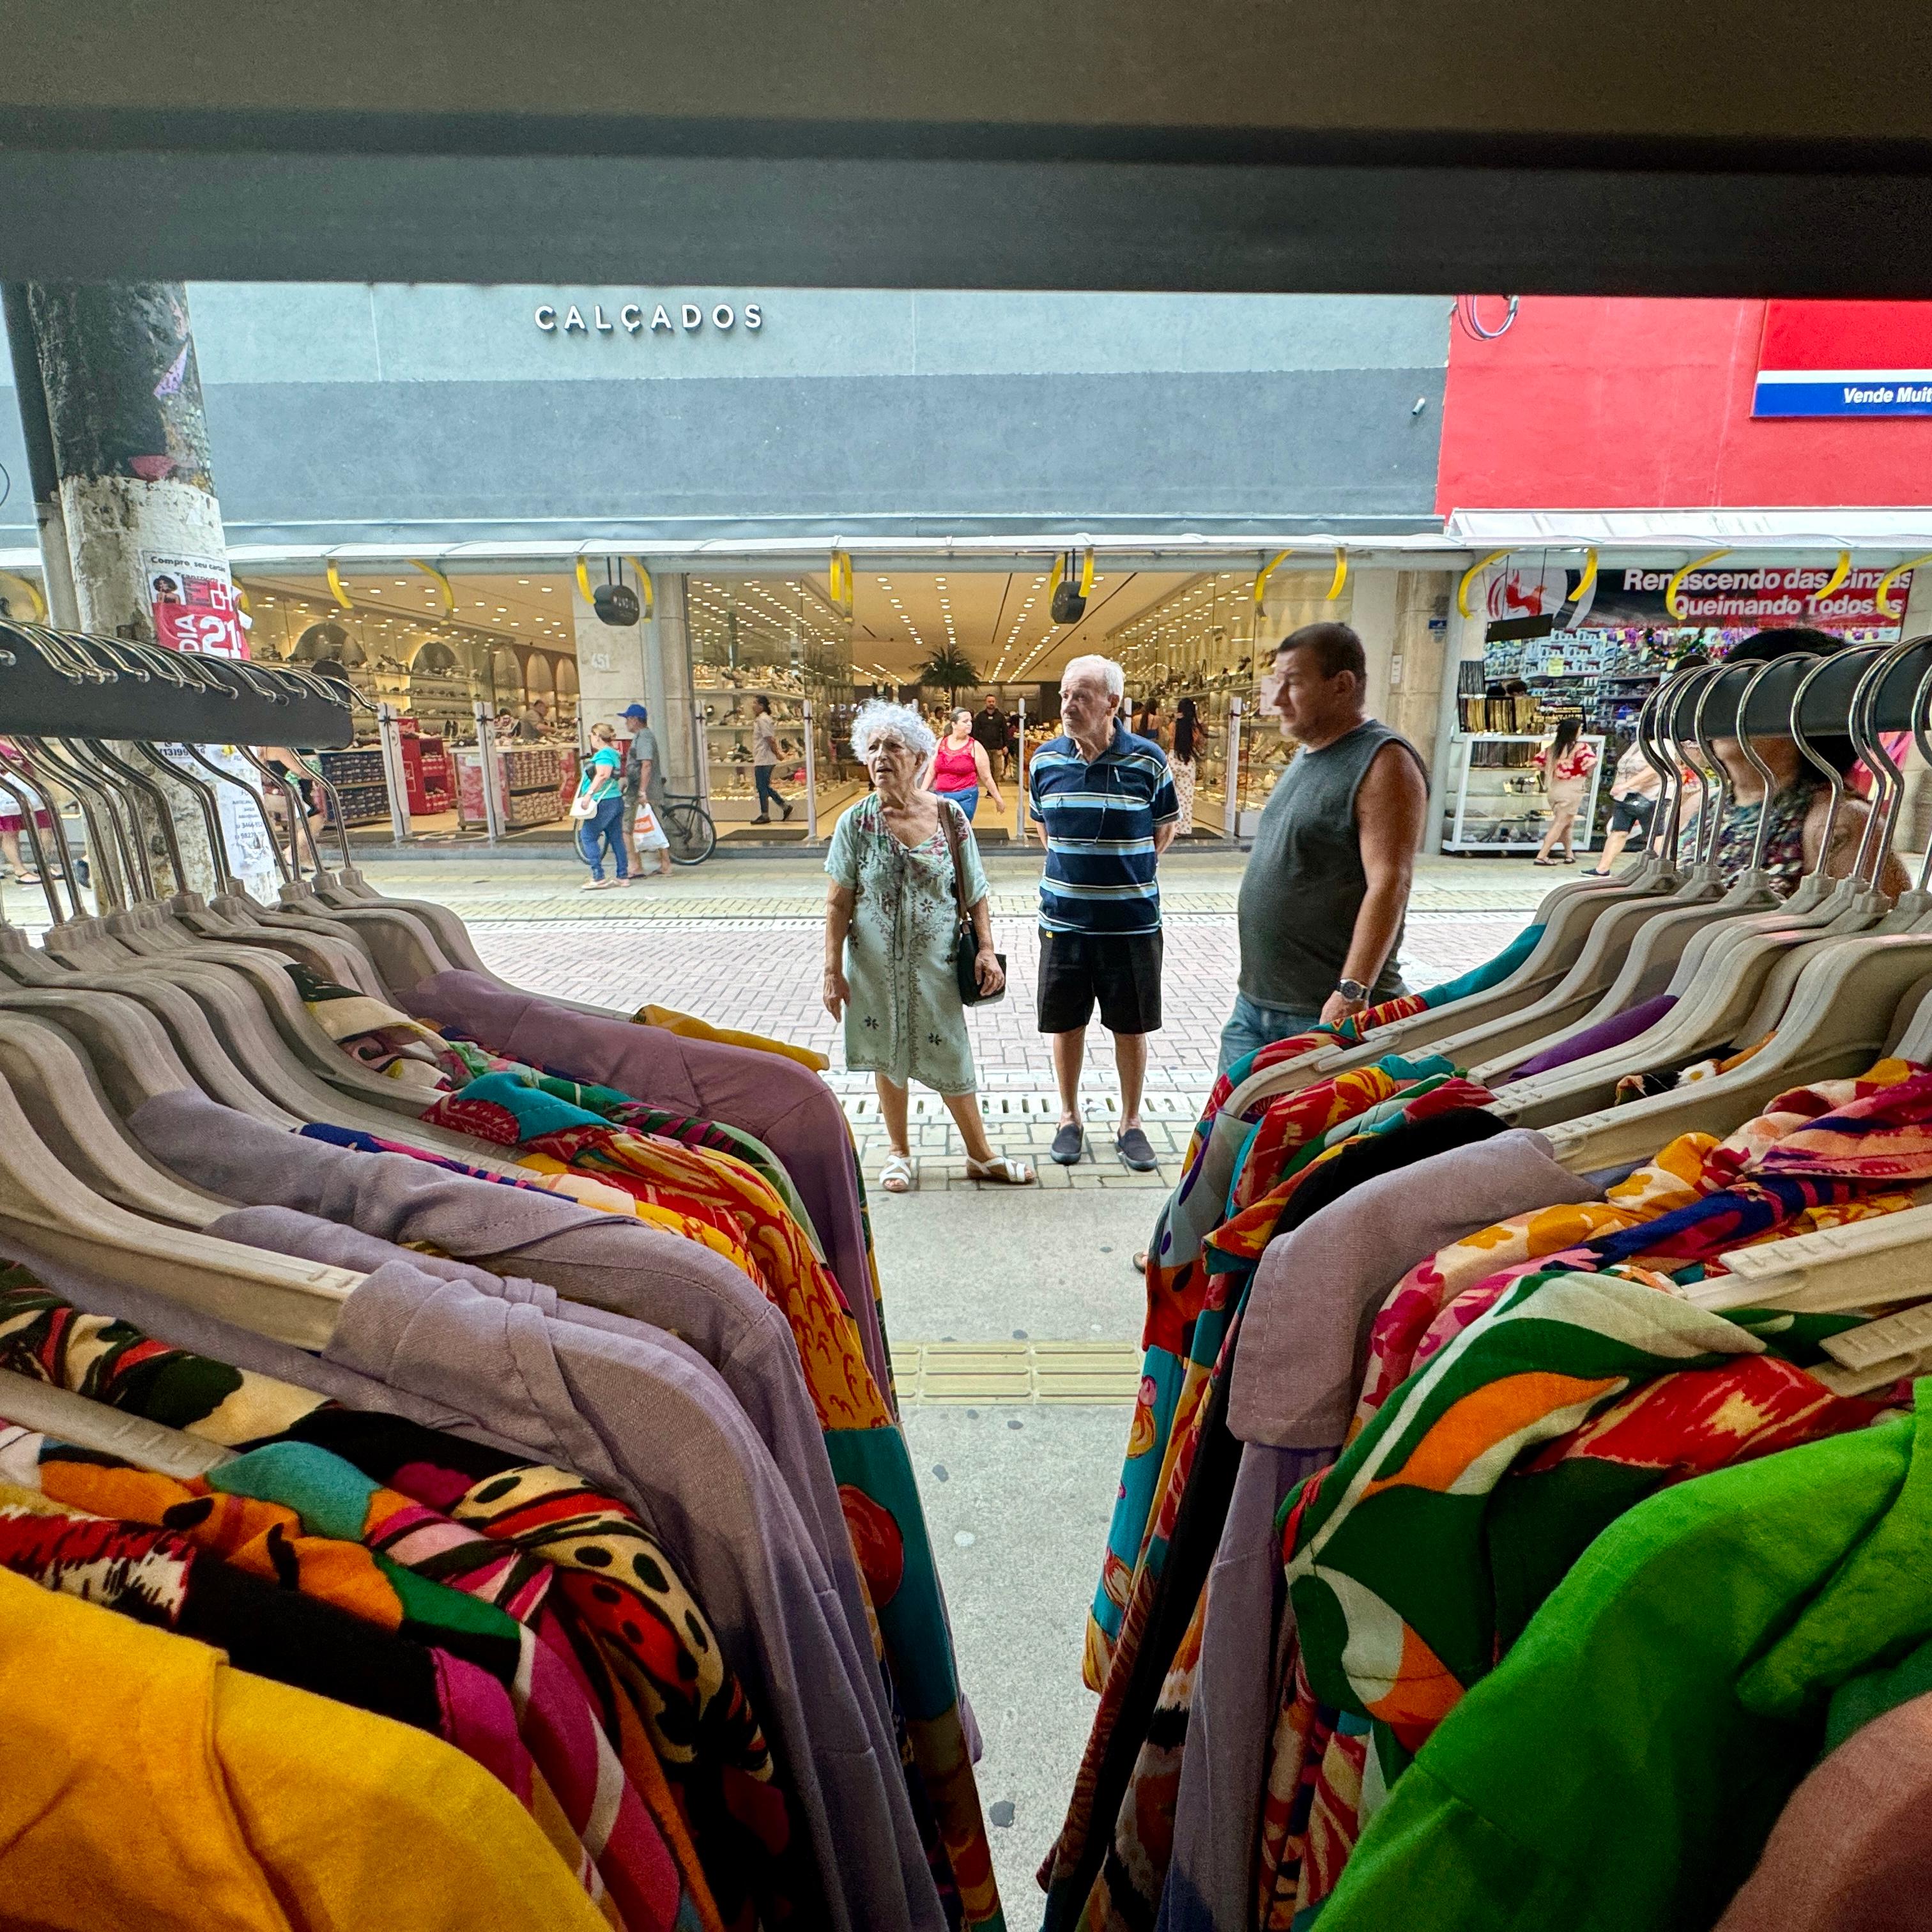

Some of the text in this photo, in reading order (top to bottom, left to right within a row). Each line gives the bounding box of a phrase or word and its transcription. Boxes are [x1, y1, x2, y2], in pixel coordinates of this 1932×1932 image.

[535, 304, 762, 333] CALÇADOS
[1844, 387, 1894, 404] Vende
[151, 556, 190, 567] Compro
[1623, 568, 1781, 591] Renascendo
[1784, 568, 1829, 590] das
[1675, 594, 1802, 617] Queimando
[1805, 594, 1874, 615] Todos
